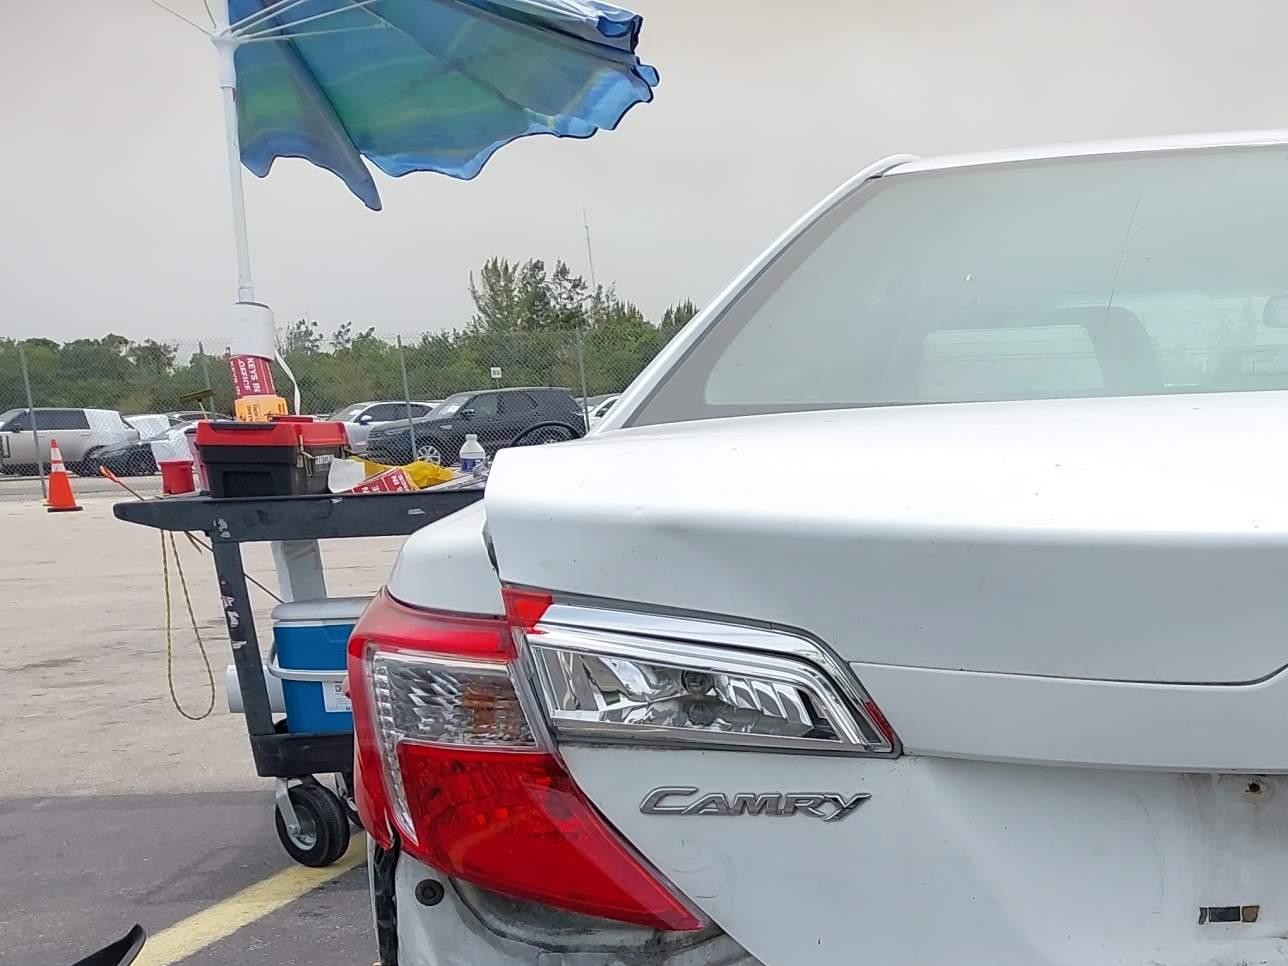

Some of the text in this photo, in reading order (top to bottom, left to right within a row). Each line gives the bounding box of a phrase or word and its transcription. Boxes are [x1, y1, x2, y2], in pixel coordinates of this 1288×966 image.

[247, 357, 259, 381] KEYS
[252, 382, 262, 393] IN
[640, 785, 872, 821] CAMRY
